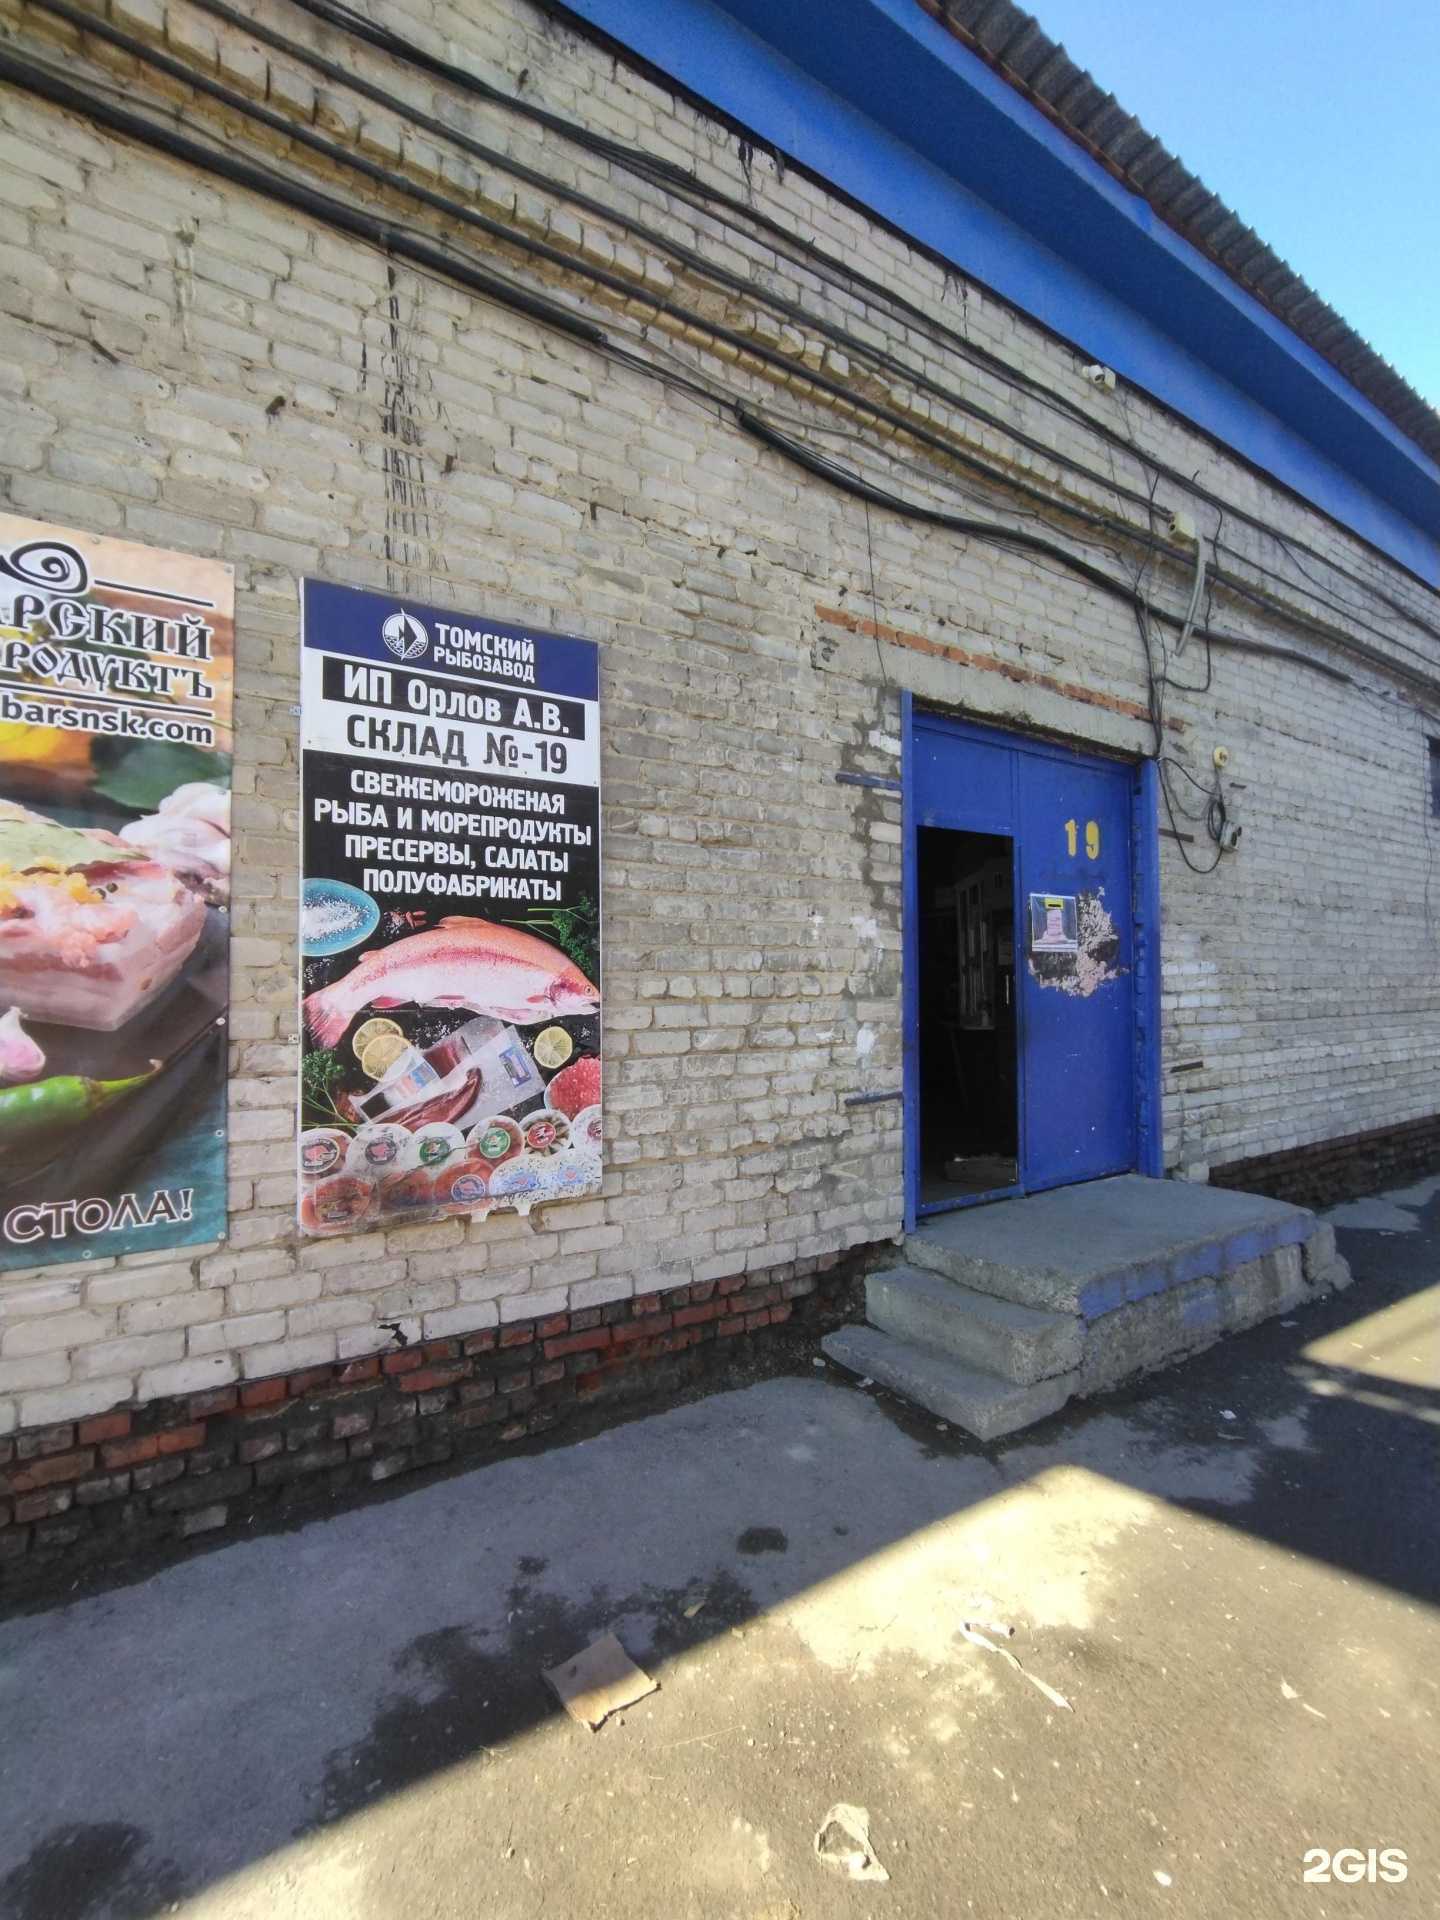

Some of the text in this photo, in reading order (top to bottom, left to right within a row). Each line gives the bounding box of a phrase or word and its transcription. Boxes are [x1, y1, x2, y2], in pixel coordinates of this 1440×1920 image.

[0, 594, 212, 660] РСКИЙ
[434, 622, 536, 663] ТОМСКИЙ
[0, 641, 213, 698] РОДУКТЪ
[433, 646, 536, 684] РЫБОЗАВОД
[2, 694, 212, 744] barsnsk.com
[344, 663, 570, 733] ИП Орлов А.В.
[346, 714, 469, 767] СКЛАД
[350, 769, 565, 814] СВЕЖЕМОРОЖЕНАЯ
[314, 798, 591, 846] РЫБА И МОРЕПРОДУКТЫ
[1064, 819, 1099, 860] 19
[345, 834, 569, 873] ПРЕСЕРВЫ, САЛАТЫ
[363, 868, 562, 901] ПОЛУФАБРИКАТЫ
[4, 1188, 193, 1243] СТОЛА!
